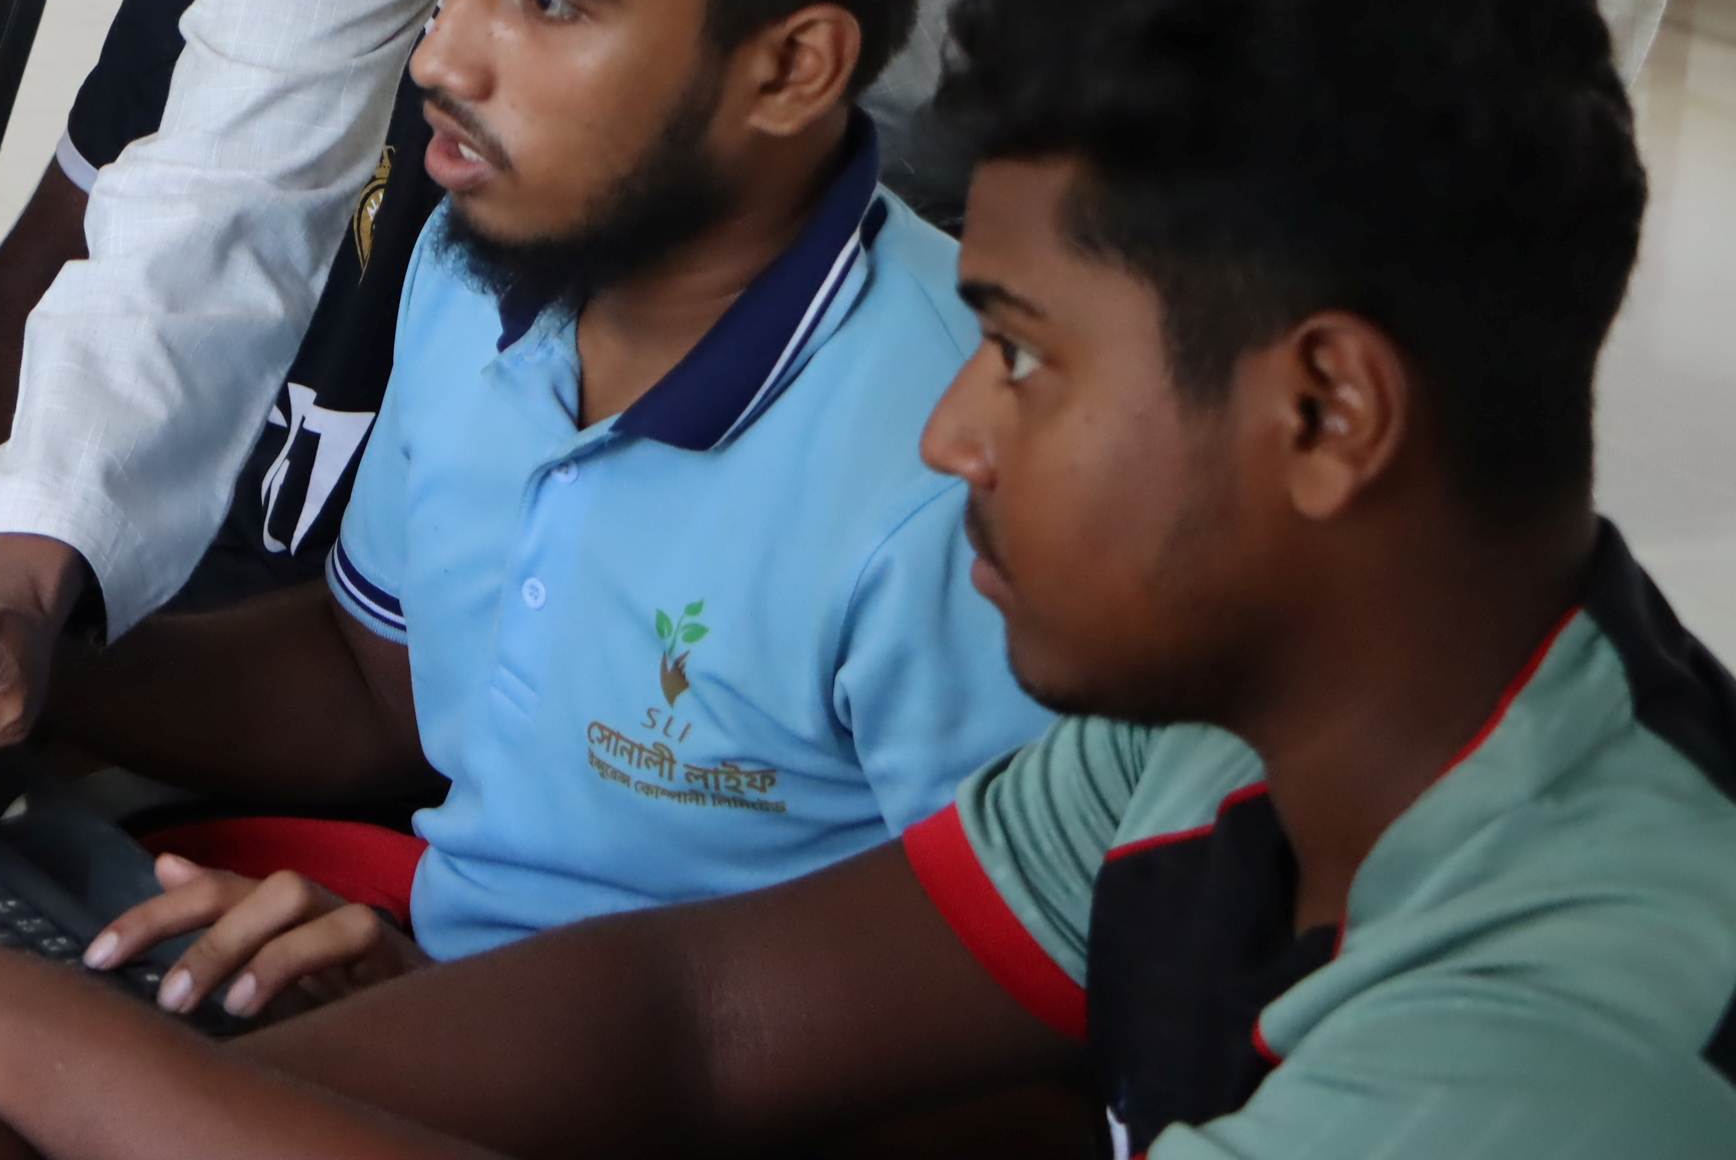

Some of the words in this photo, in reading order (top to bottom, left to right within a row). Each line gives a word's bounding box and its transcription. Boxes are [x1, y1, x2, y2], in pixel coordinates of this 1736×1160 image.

[640, 706, 692, 744] SLI
[586, 720, 676, 782] সোনালী
[682, 760, 777, 794] লাইফ
